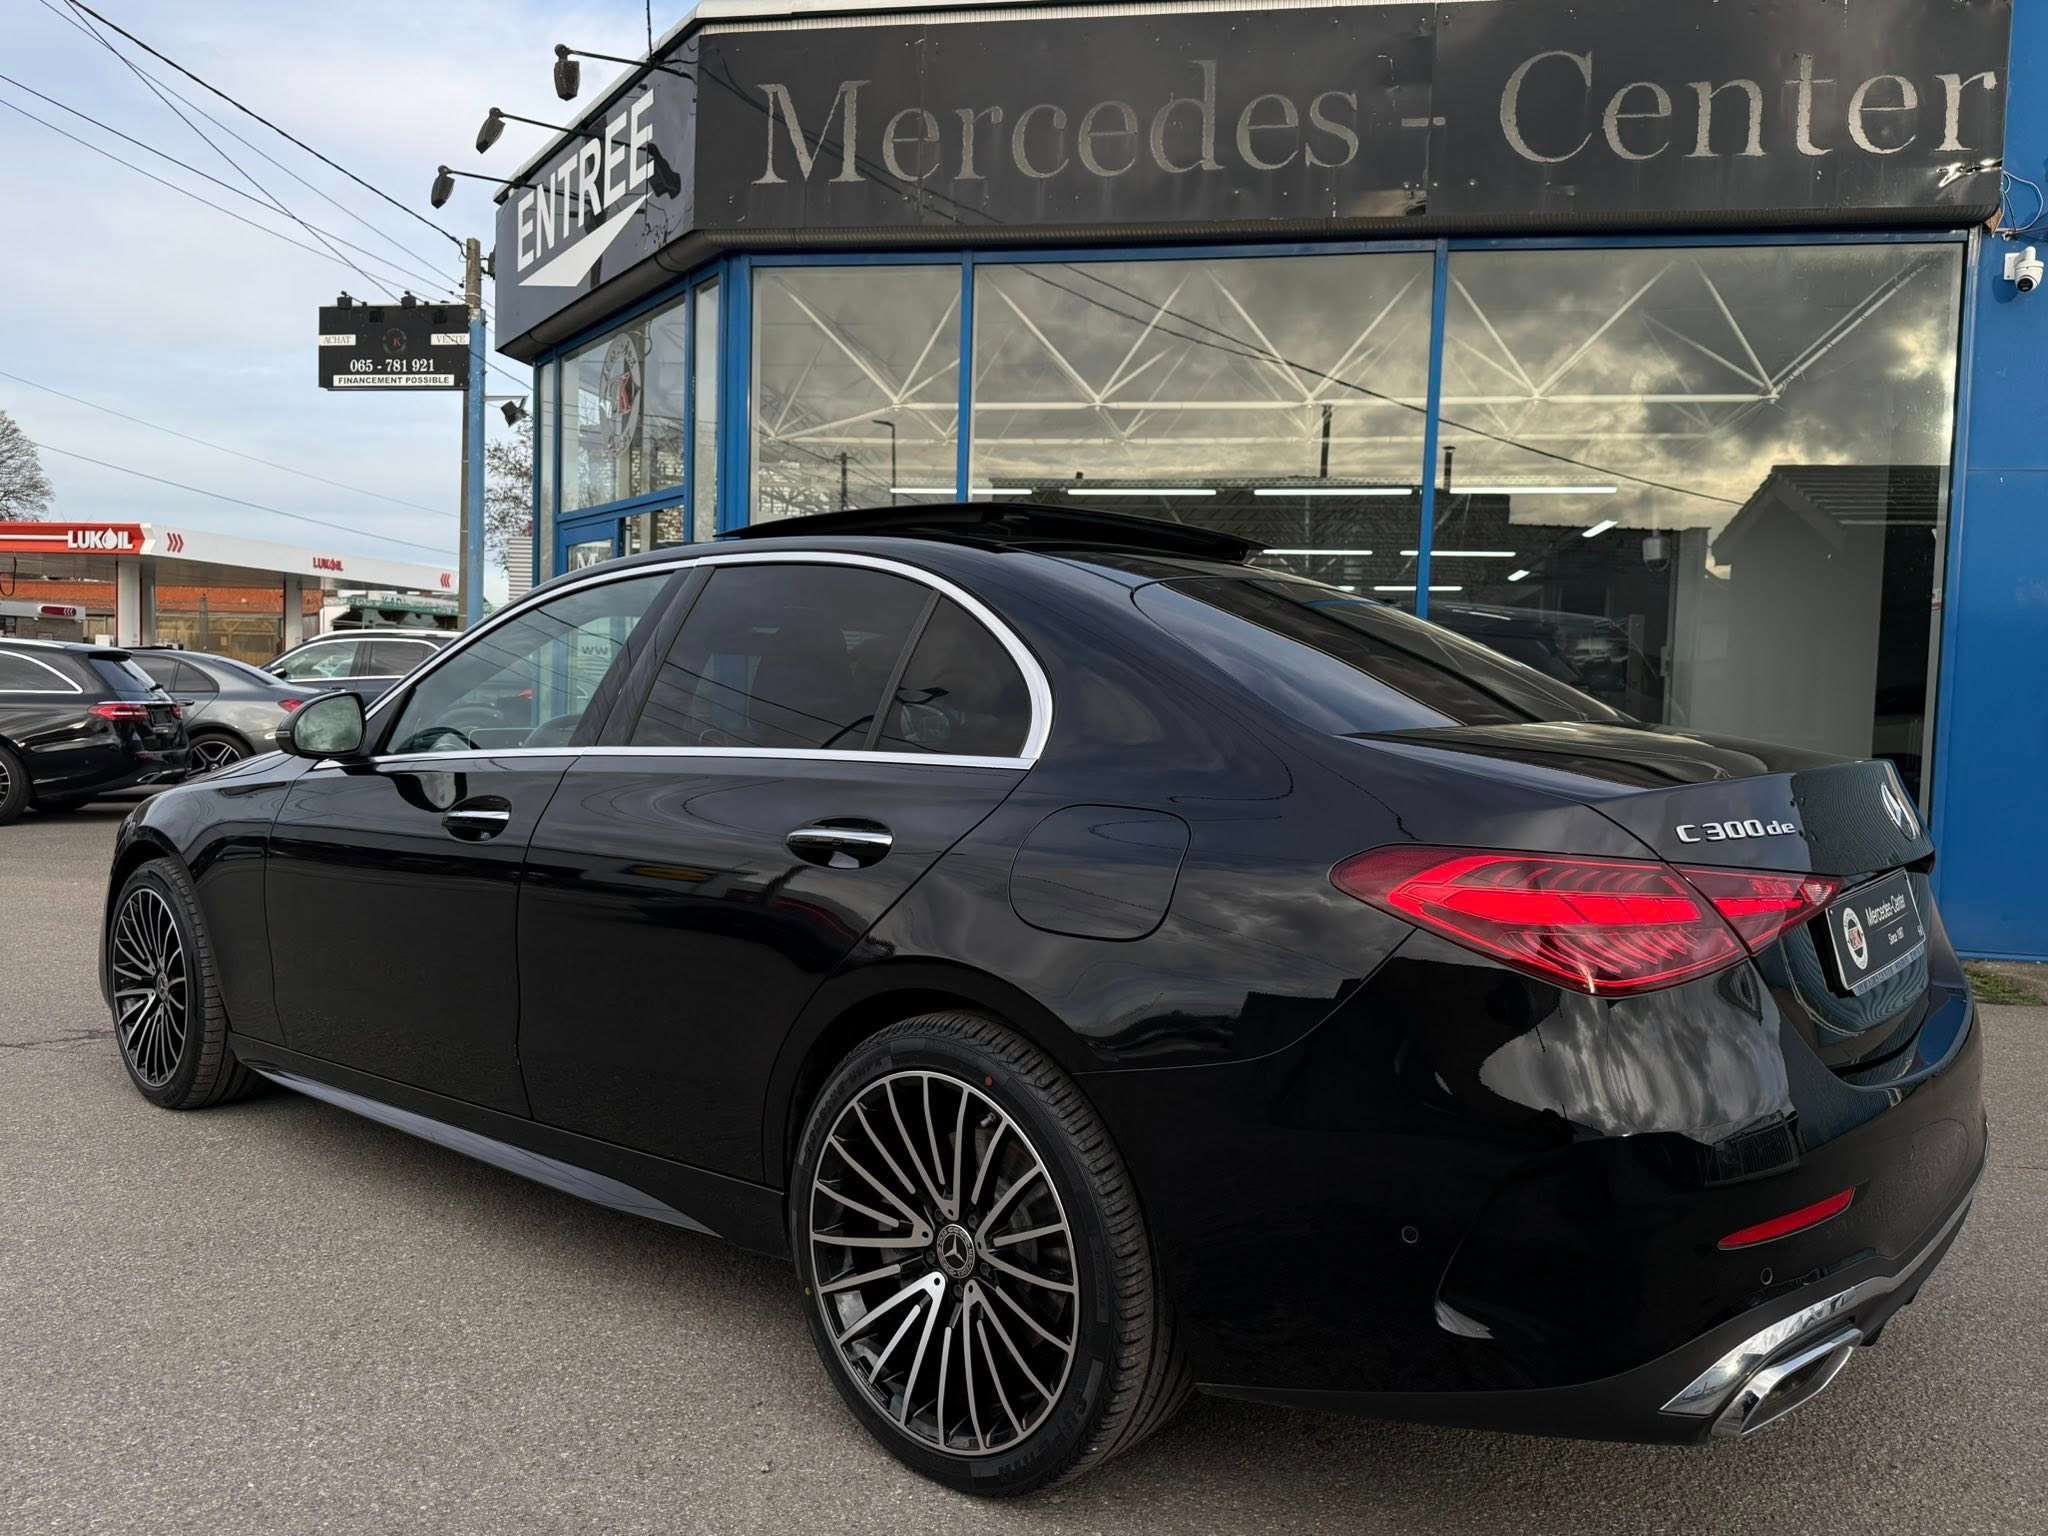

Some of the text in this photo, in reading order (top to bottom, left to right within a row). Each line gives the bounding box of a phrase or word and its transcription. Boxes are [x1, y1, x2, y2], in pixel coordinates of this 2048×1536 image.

[751, 59, 1359, 185] Mercedes
[1500, 50, 1998, 164] Center
[517, 88, 655, 273] ENTREE
[323, 335, 352, 345] ACHAT
[436, 335, 467, 345] VENTE
[350, 359, 373, 372] 065
[385, 359, 407, 372] 781
[412, 358, 435, 372] 921
[338, 376, 450, 385] FINANCEMENT POSSIBLE
[67, 528, 134, 550] LUKOIL
[313, 556, 344, 571] LUKOIL
[1676, 819, 1797, 843] C 300 de
[1865, 893, 1907, 927] Mercedes-Center
